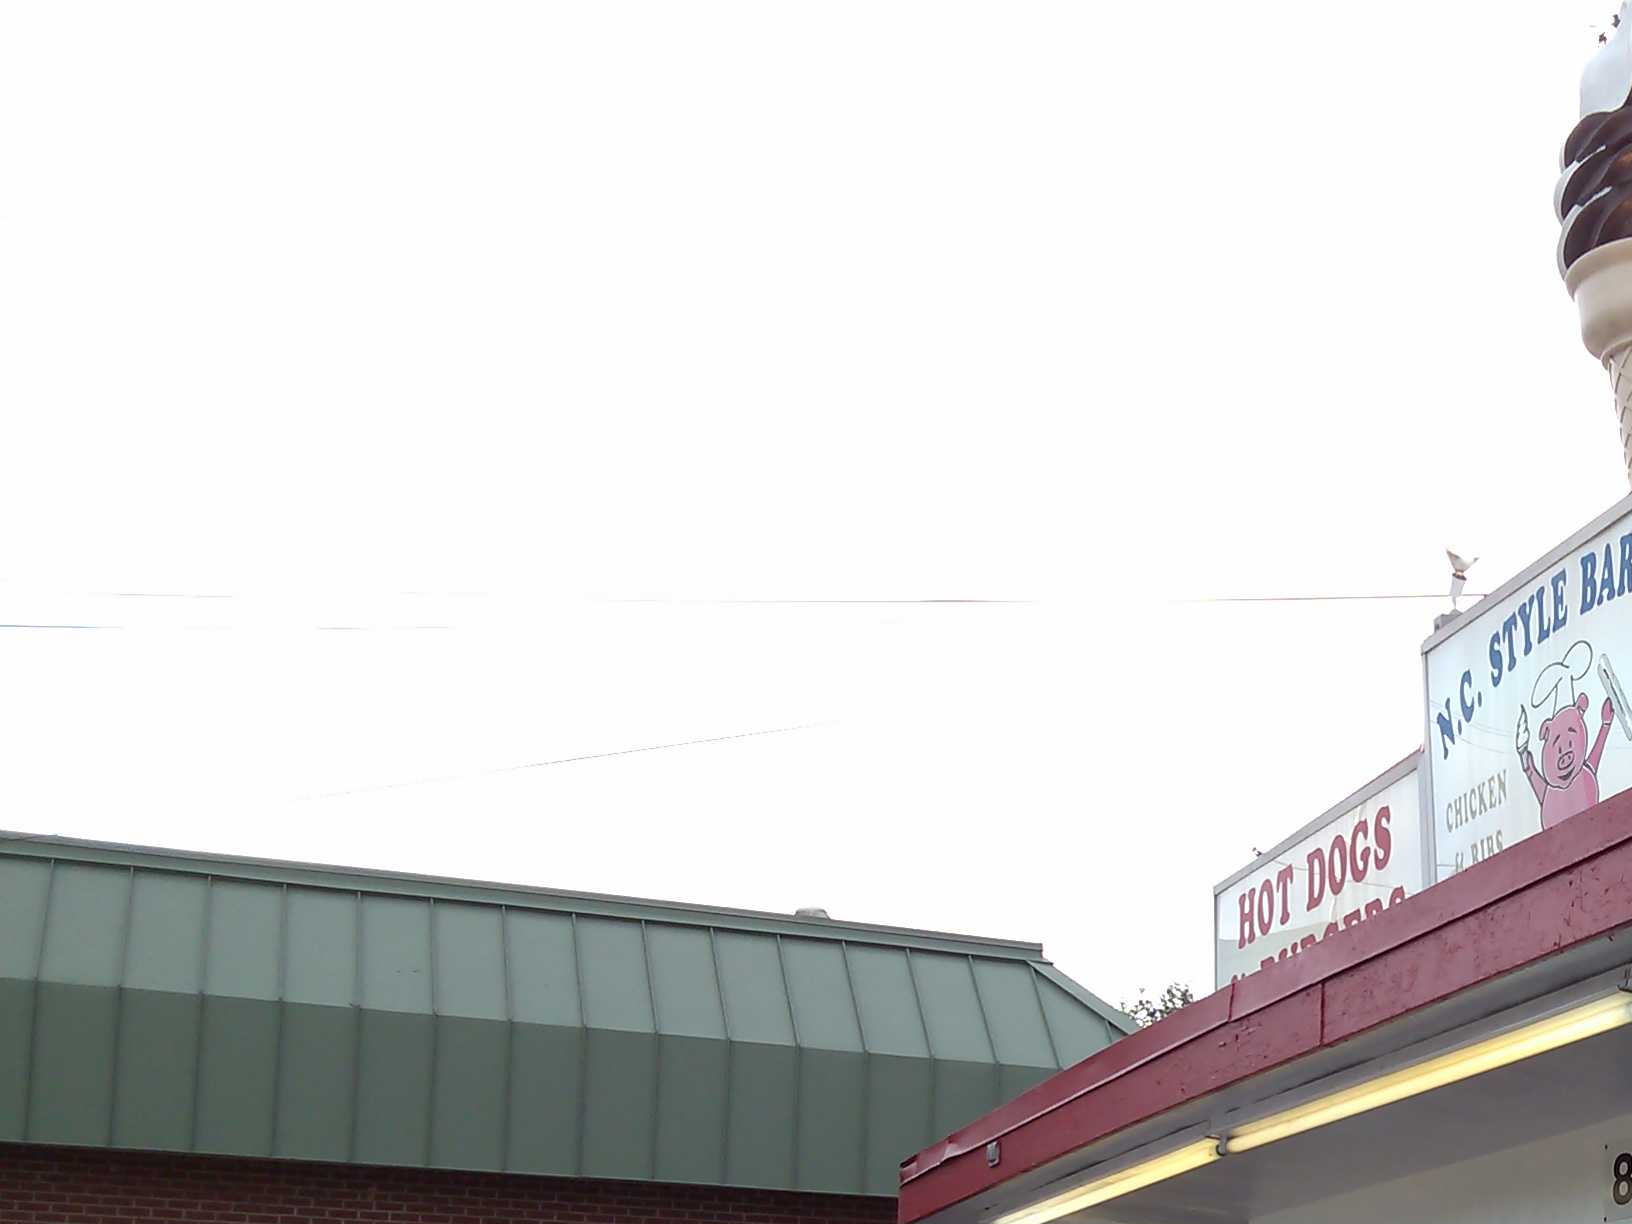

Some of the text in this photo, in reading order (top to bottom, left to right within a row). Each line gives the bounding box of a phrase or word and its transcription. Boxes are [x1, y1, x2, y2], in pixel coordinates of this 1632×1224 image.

[1436, 668, 1482, 760] N.C.
[1488, 567, 1568, 689] STYLE
[1445, 768, 1507, 833] CHICKEN
[1238, 864, 1294, 949] HOT
[1306, 804, 1393, 912] DOGS
